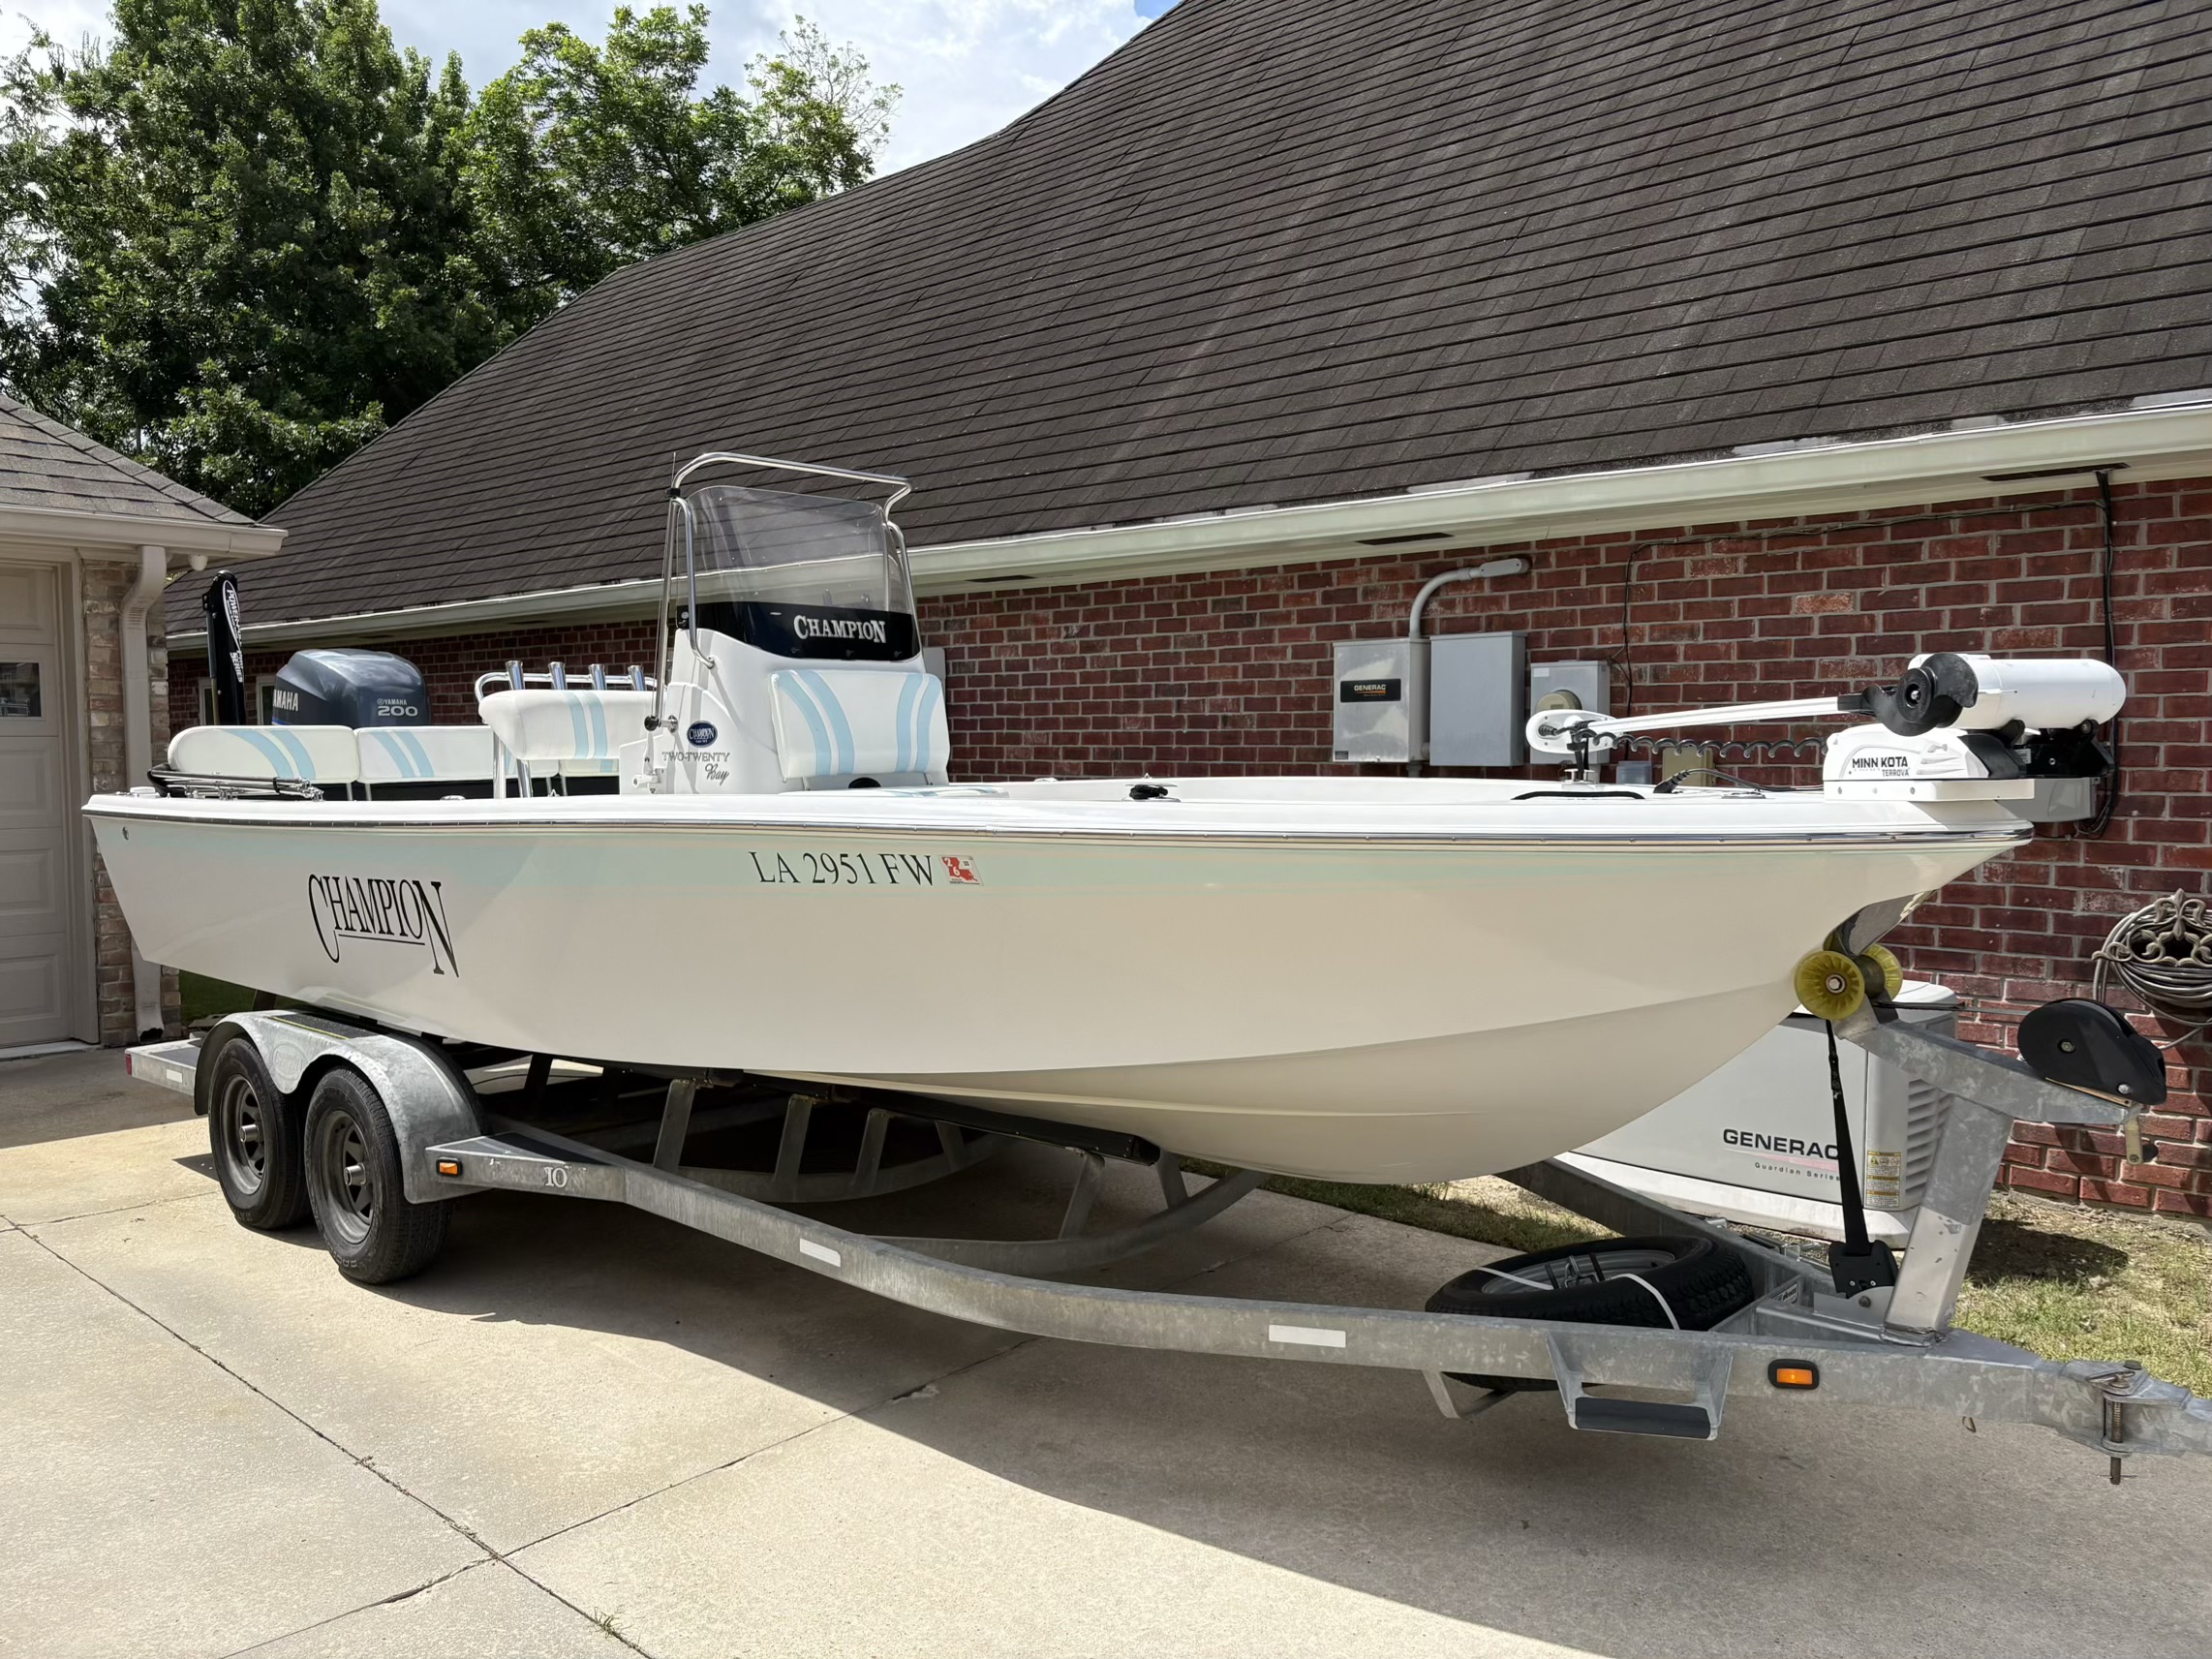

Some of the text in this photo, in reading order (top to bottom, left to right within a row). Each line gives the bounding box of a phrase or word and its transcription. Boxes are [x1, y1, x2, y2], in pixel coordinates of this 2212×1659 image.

[793, 614, 886, 643] CHAMPION
[272, 689, 298, 712] AMAHA
[378, 706, 418, 717] 200
[1852, 756, 1909, 768] MINN KOTA
[705, 763, 730, 785] Bay
[748, 851, 934, 886] LA 2951 FW
[308, 874, 459, 978] CHAMPION
[1723, 1128, 1838, 1160] GENERAC
[1754, 1162, 1840, 1182] Guardian Series
